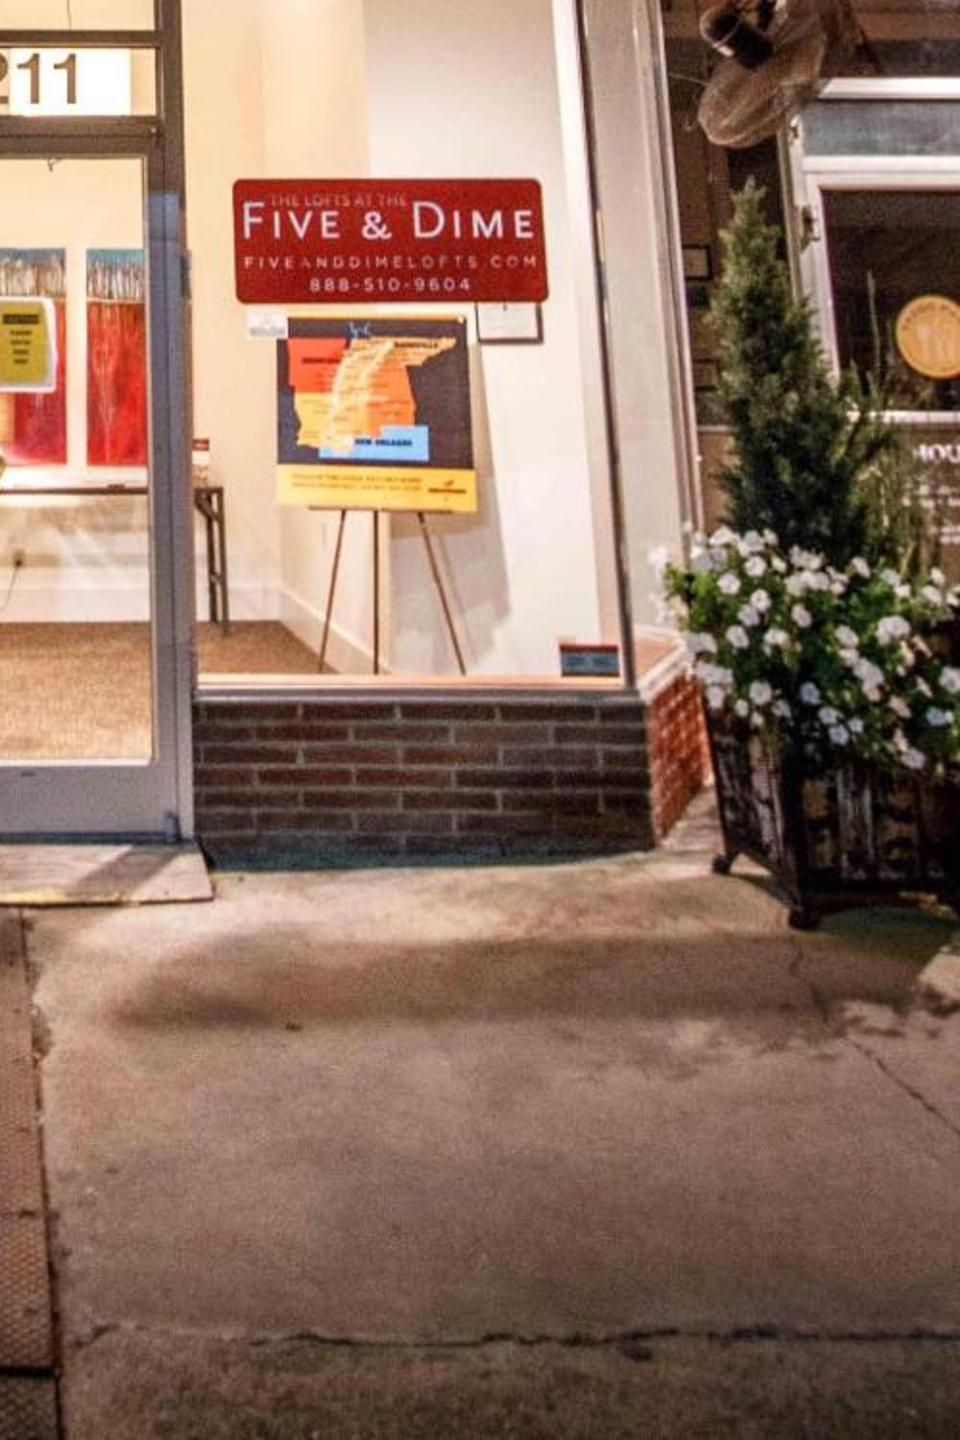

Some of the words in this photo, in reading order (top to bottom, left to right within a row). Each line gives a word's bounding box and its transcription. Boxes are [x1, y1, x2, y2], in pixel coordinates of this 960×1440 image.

[271, 192, 299, 207] THE
[304, 192, 350, 207] LOFTS
[354, 192, 374, 207] AT
[376, 192, 407, 207] THE
[242, 200, 341, 240] FIVE
[361, 210, 392, 240] &
[412, 200, 534, 239] DIME
[308, 277, 472, 293] 888-510-9604
